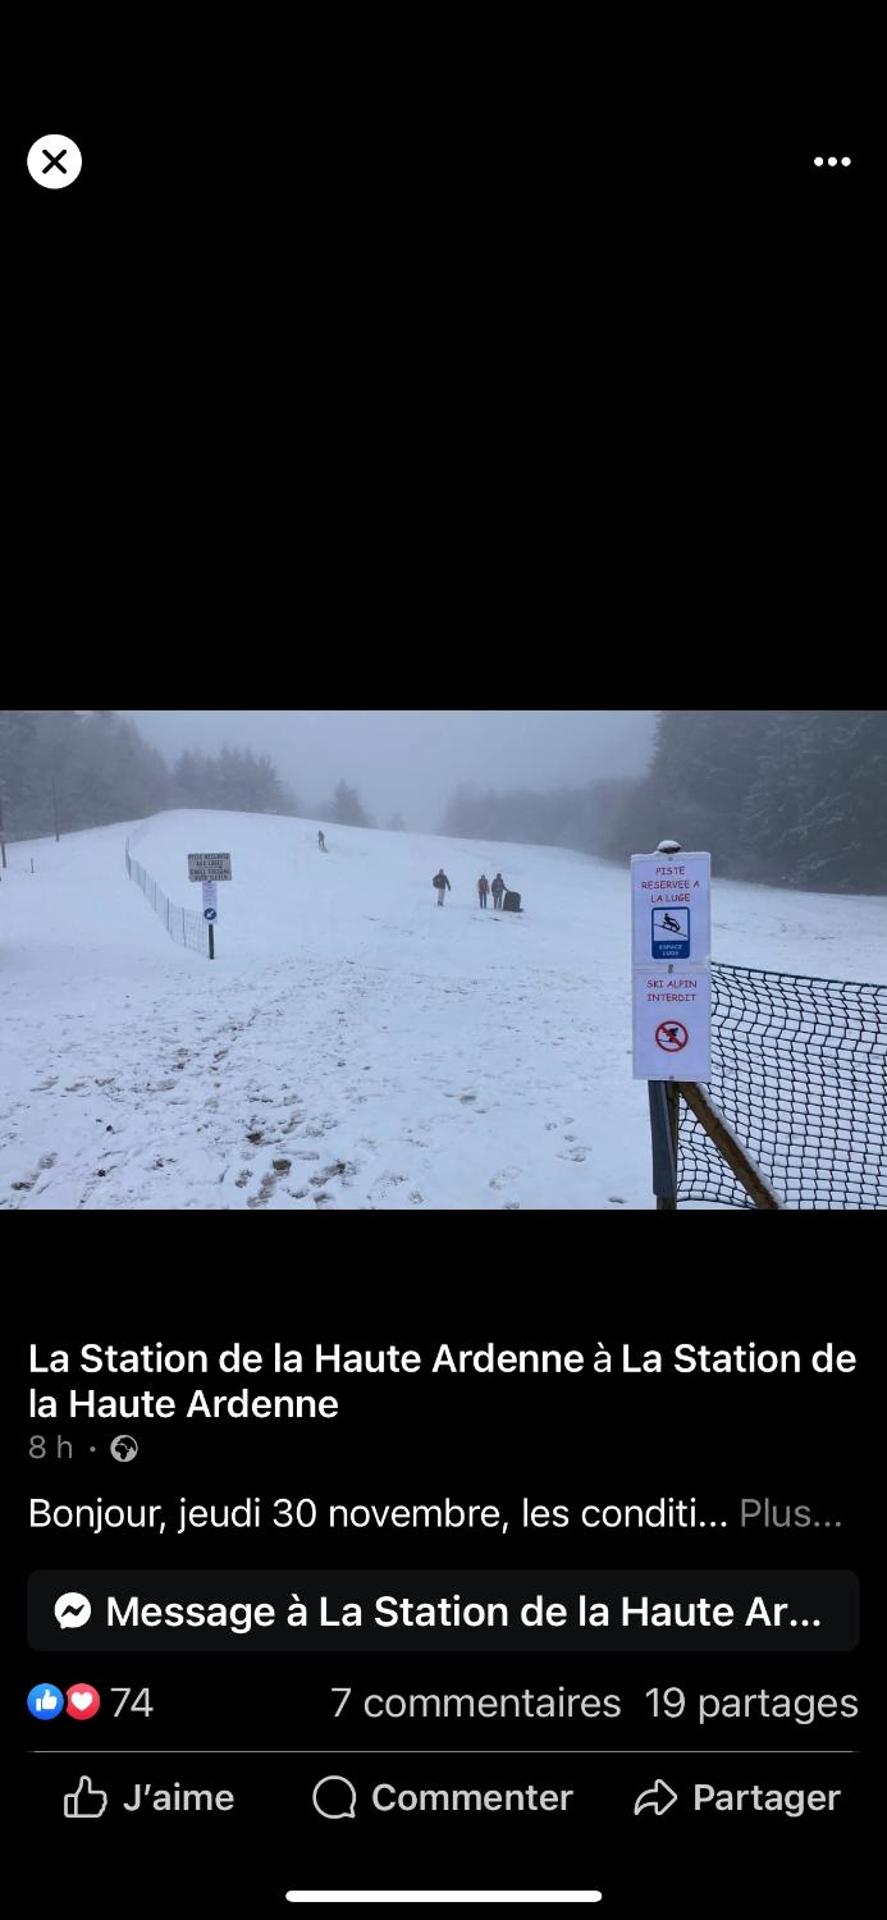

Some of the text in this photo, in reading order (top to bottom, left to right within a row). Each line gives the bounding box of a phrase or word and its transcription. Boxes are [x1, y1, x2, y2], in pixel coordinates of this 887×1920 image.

[655, 865, 686, 876] PISTE
[641, 879, 690, 889] RESERVEE
[650, 893, 691, 903] LA LUGE
[647, 979, 697, 989] SKI ALPIN
[647, 992, 697, 1002] INTERDIT
